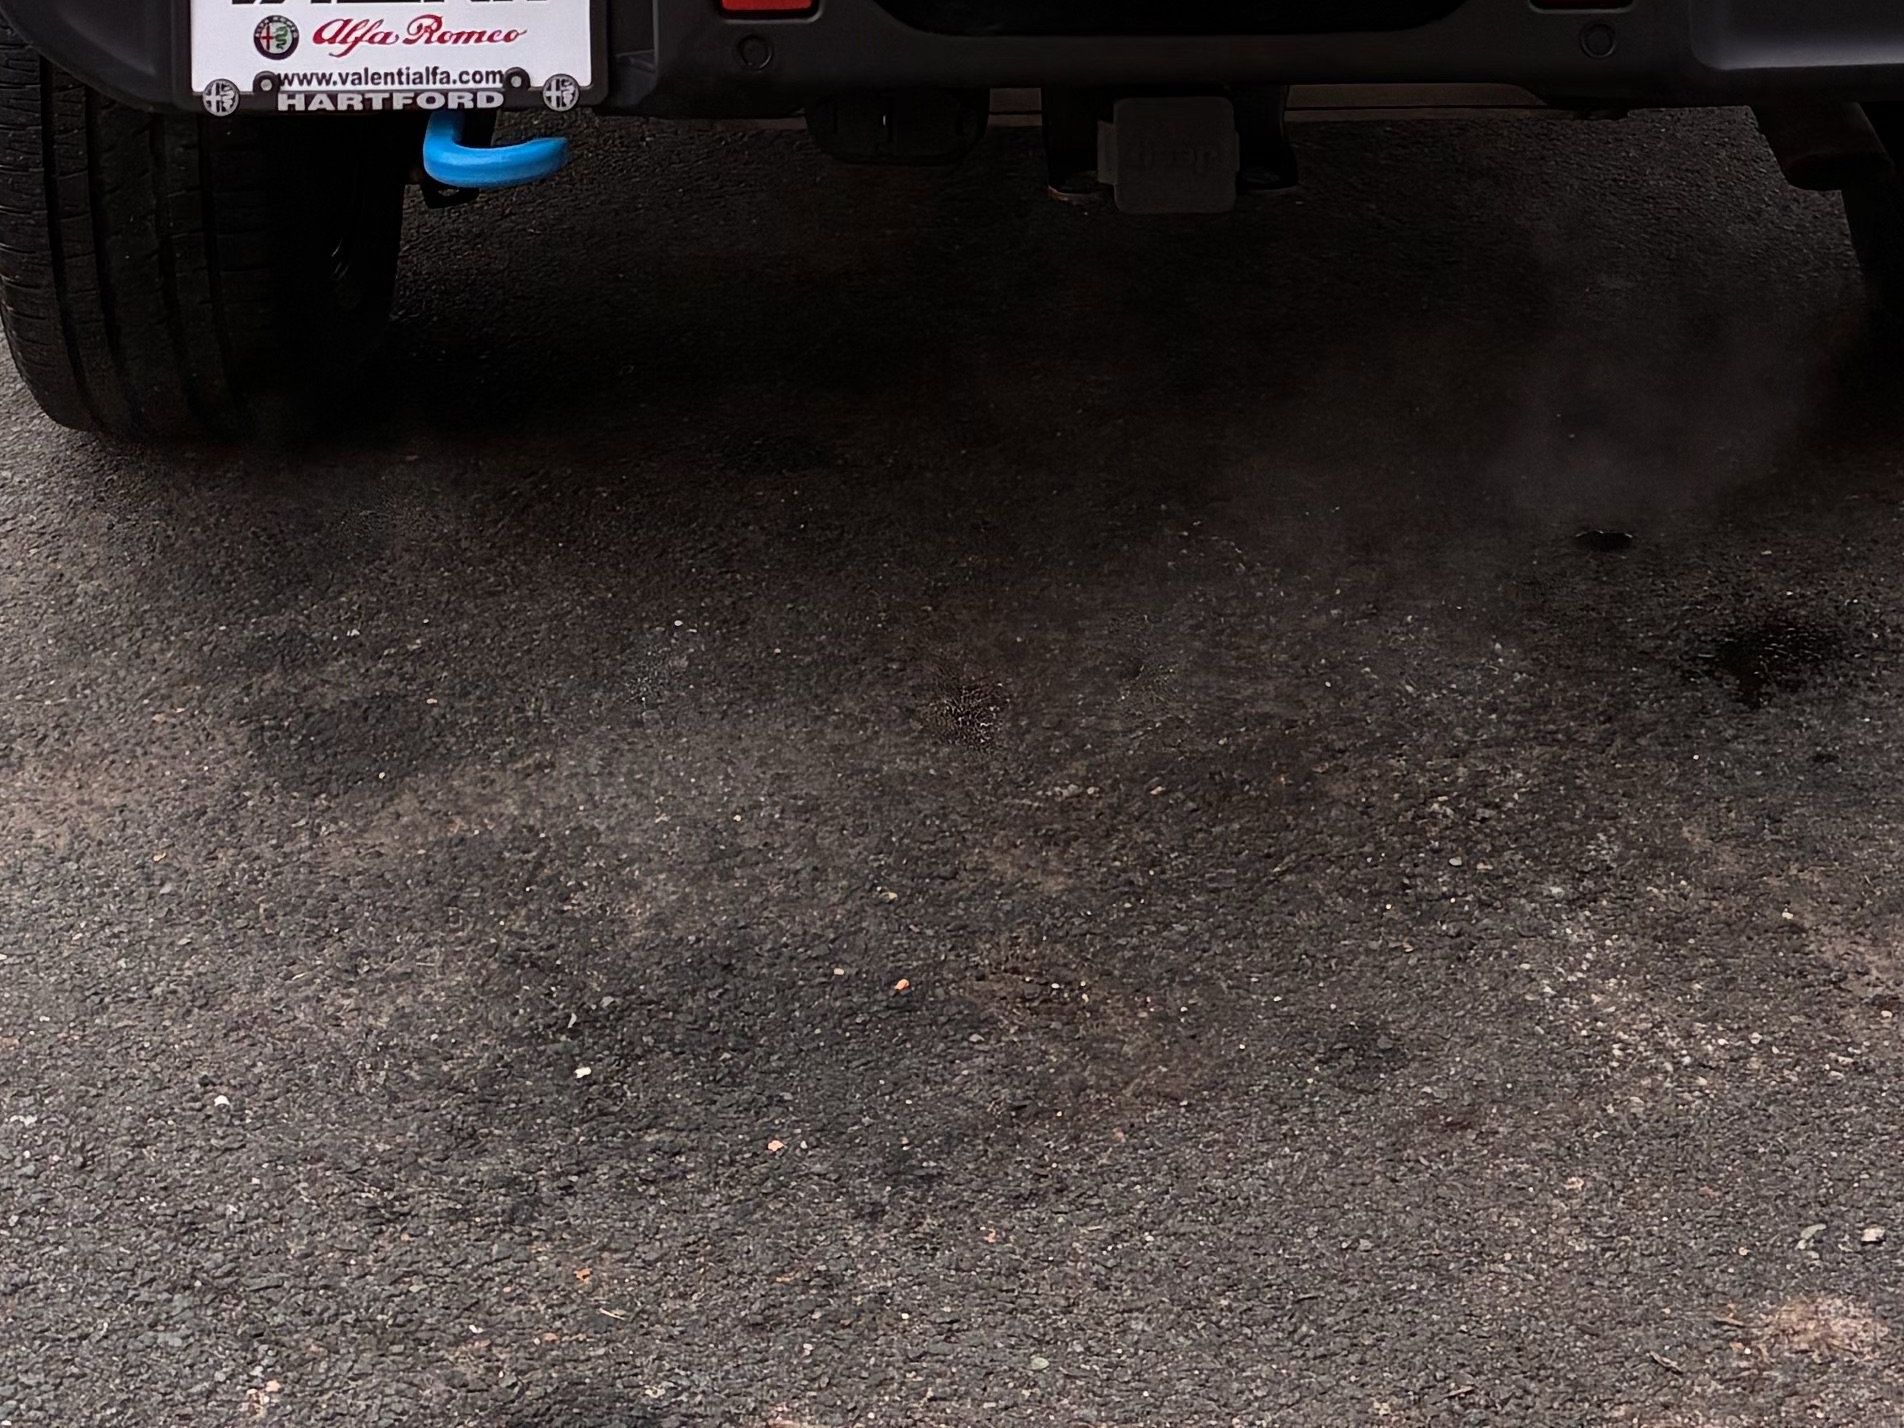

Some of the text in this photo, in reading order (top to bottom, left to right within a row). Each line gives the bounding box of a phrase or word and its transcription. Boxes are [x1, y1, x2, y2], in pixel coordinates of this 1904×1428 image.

[312, 18, 399, 58] Alfa
[402, 14, 527, 46] Romeo
[277, 66, 505, 88] www.valentialfa.com
[277, 91, 504, 112] HARTFORD
